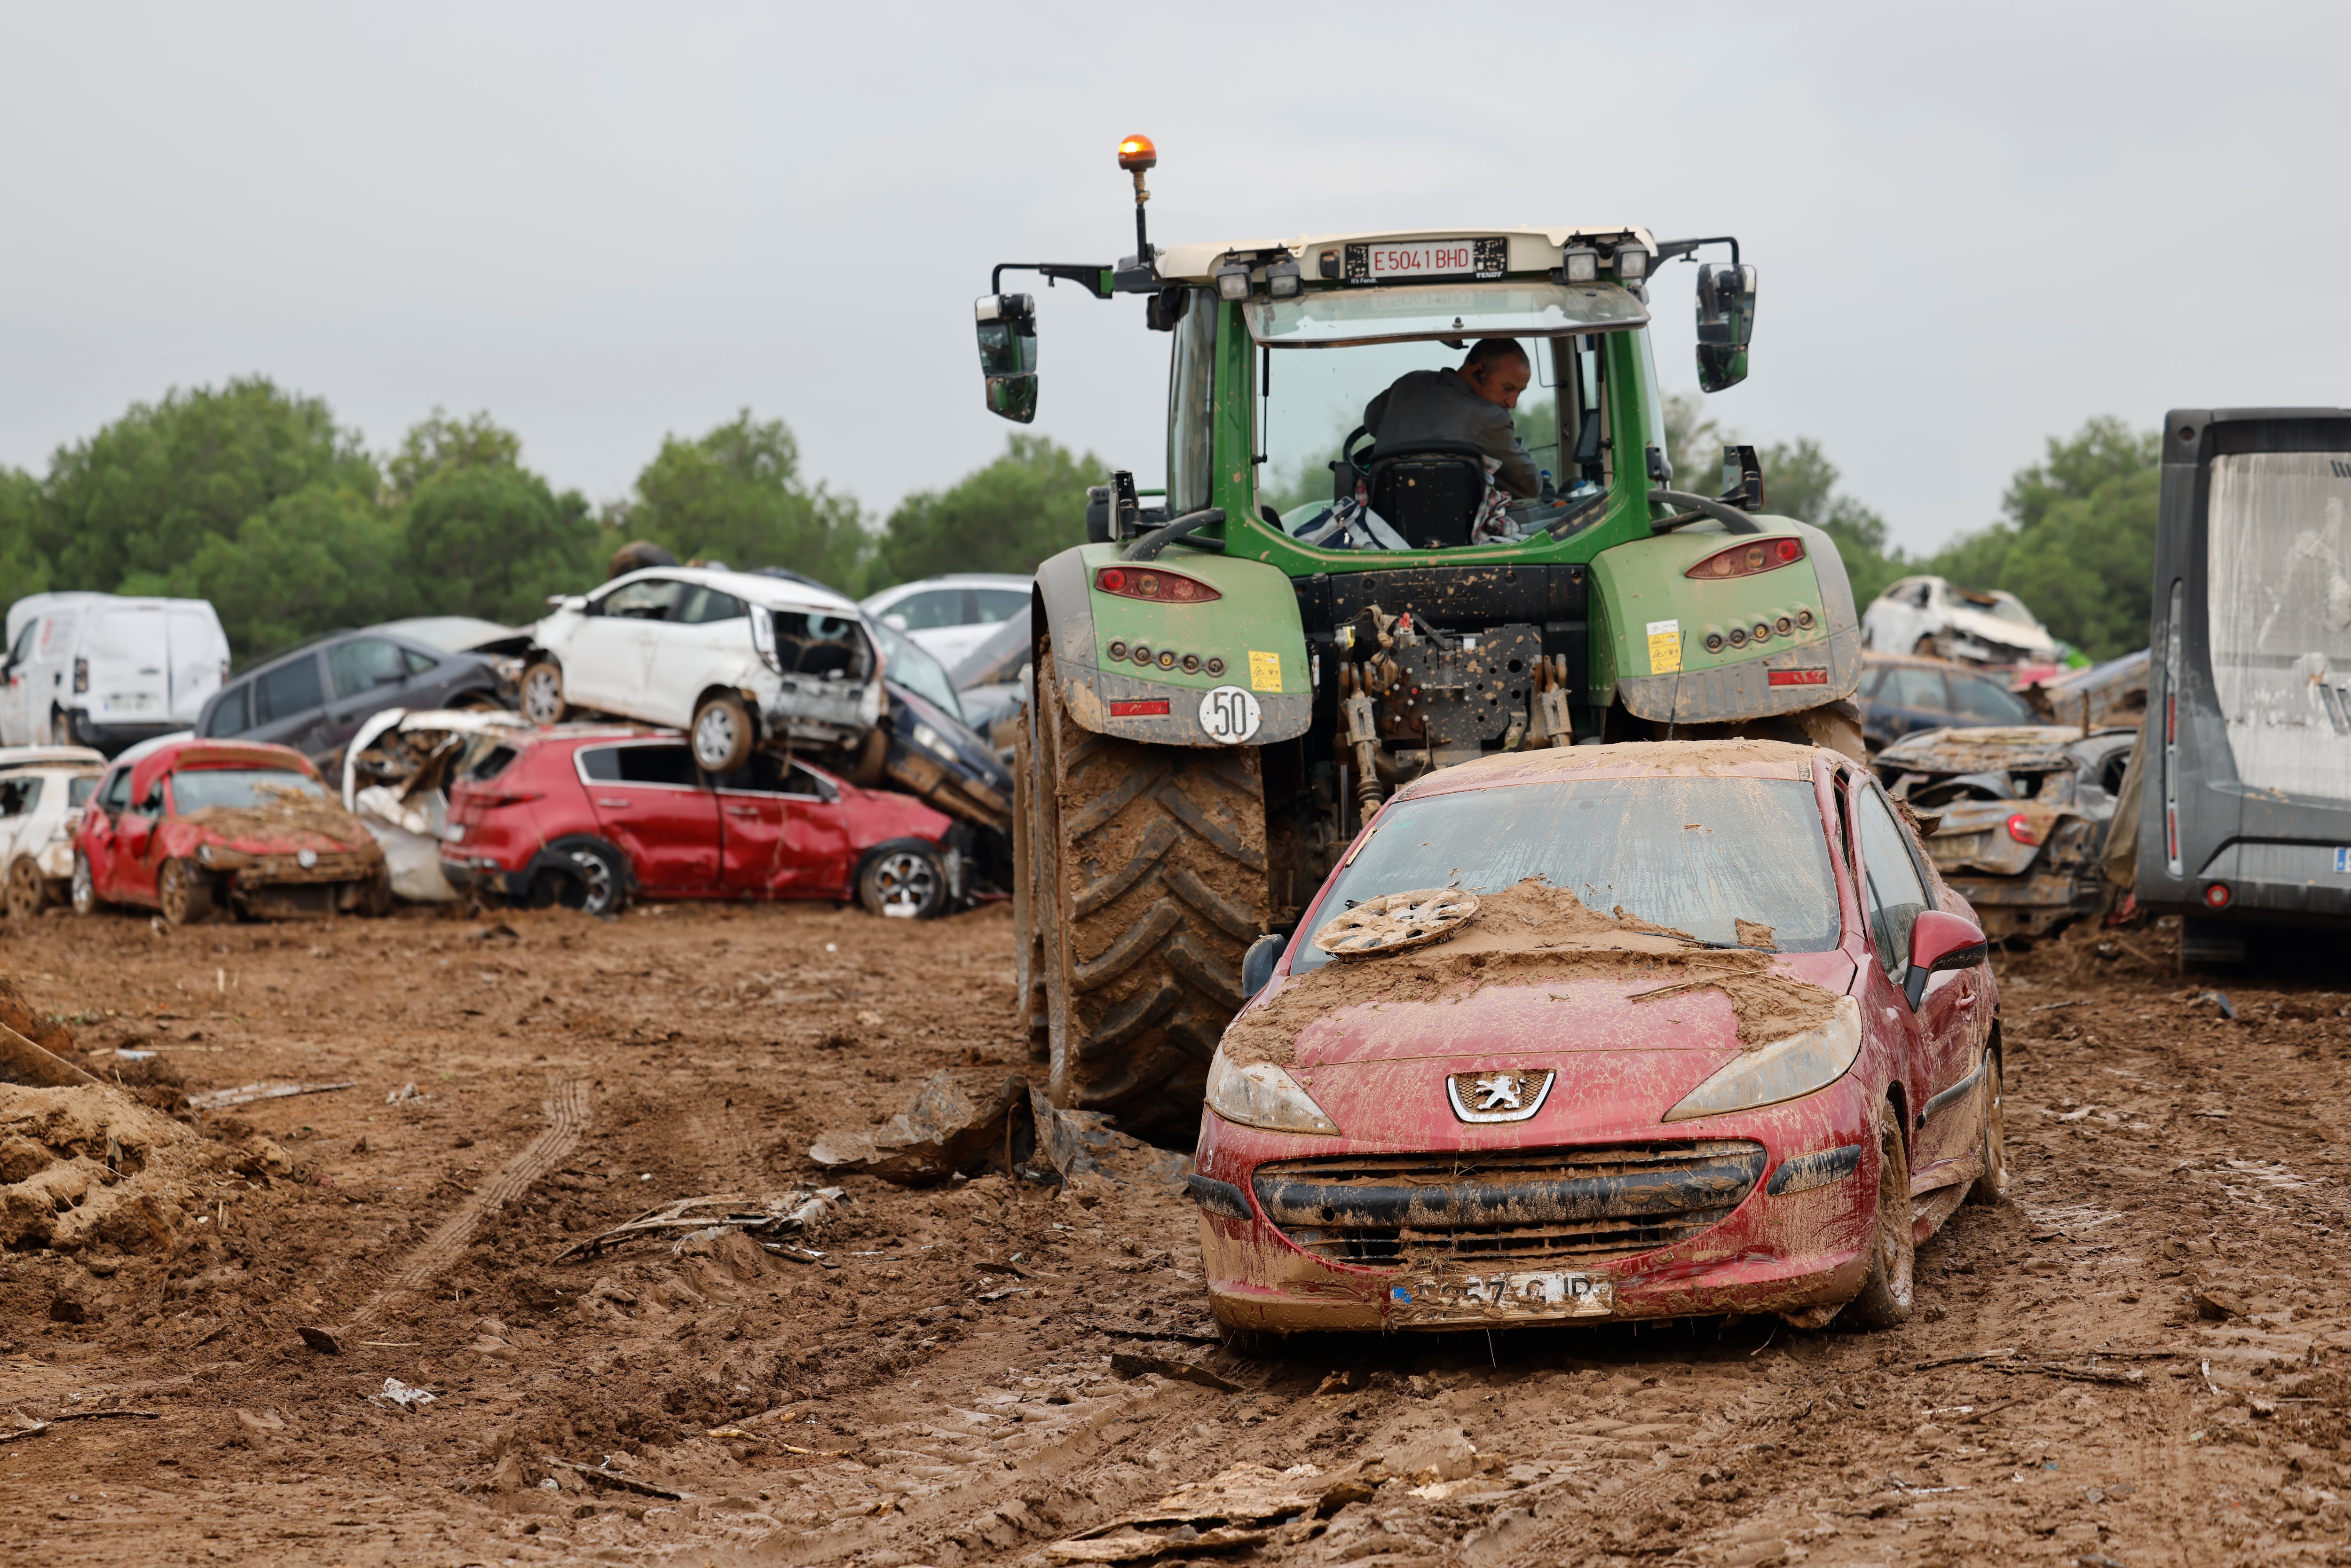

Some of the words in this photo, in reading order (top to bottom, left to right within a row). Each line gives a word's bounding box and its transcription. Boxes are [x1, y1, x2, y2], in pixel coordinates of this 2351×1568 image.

[1374, 251, 1385, 271] E
[1389, 250, 1430, 270] 5041
[1436, 248, 1468, 268] BHD
[1214, 692, 1247, 736] 50
